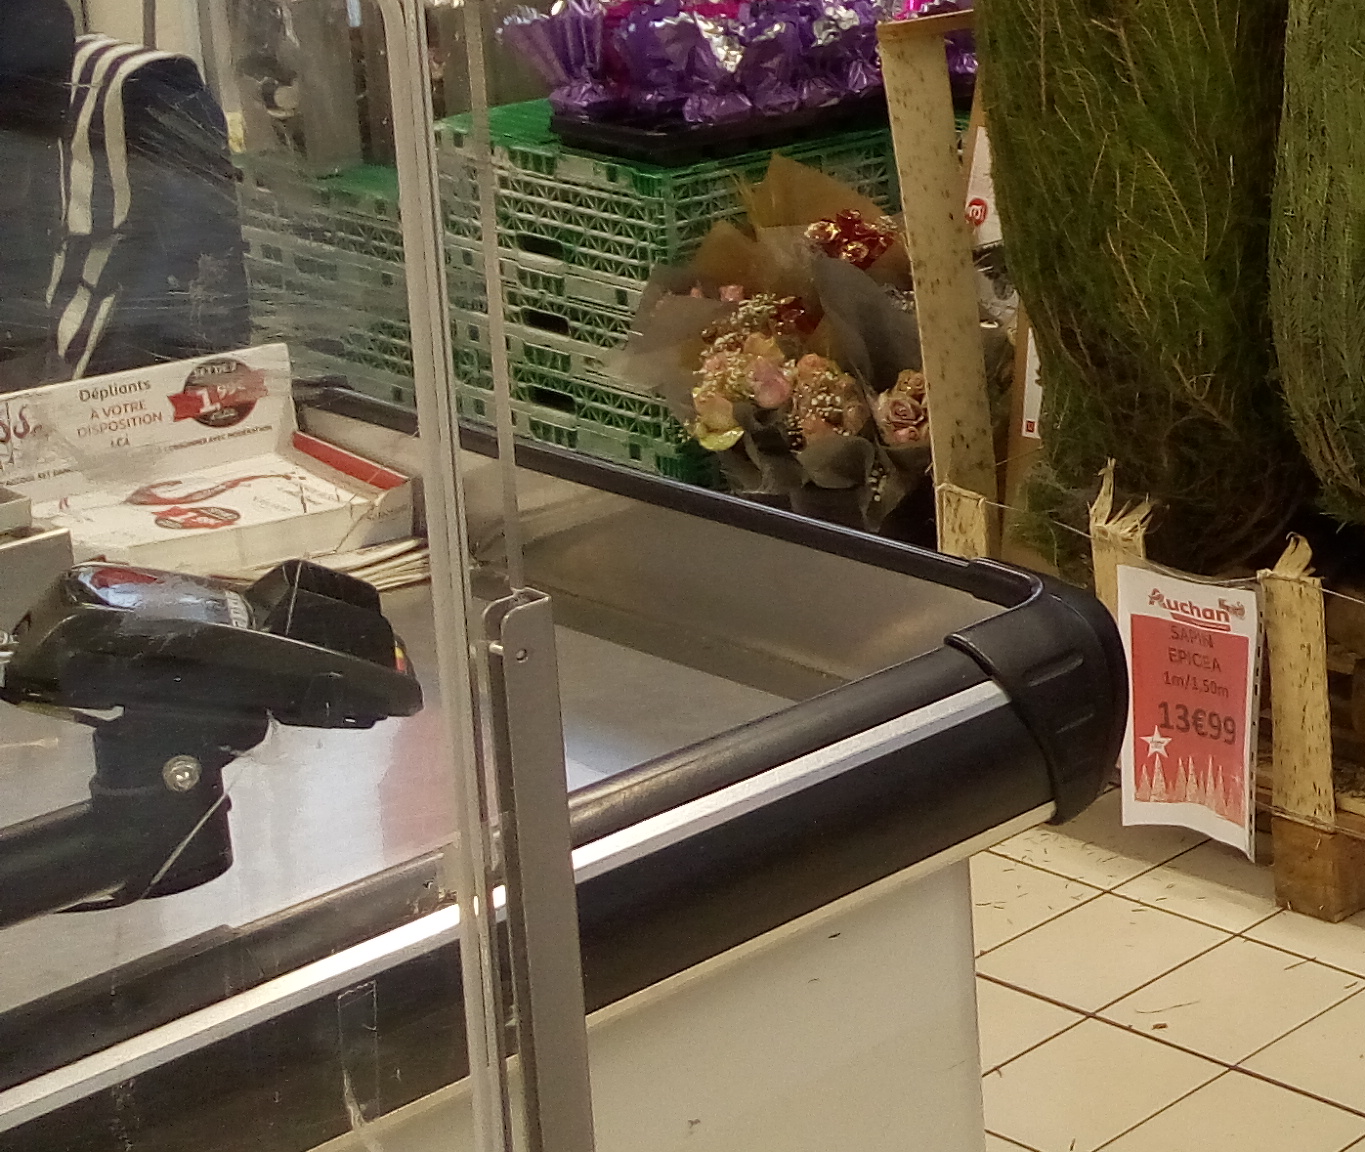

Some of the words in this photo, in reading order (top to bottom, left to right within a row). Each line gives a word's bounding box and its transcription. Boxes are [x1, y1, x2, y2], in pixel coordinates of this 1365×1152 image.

[78, 379, 152, 402] Dépliants
[102, 399, 146, 417] VOTRE
[77, 411, 163, 438] DISPOSITION
[1148, 588, 1230, 623] Auchan
[1169, 625, 1214, 648] SAPIN
[1168, 647, 1222, 673] EPICEA
[1157, 701, 1236, 745] 13€99
